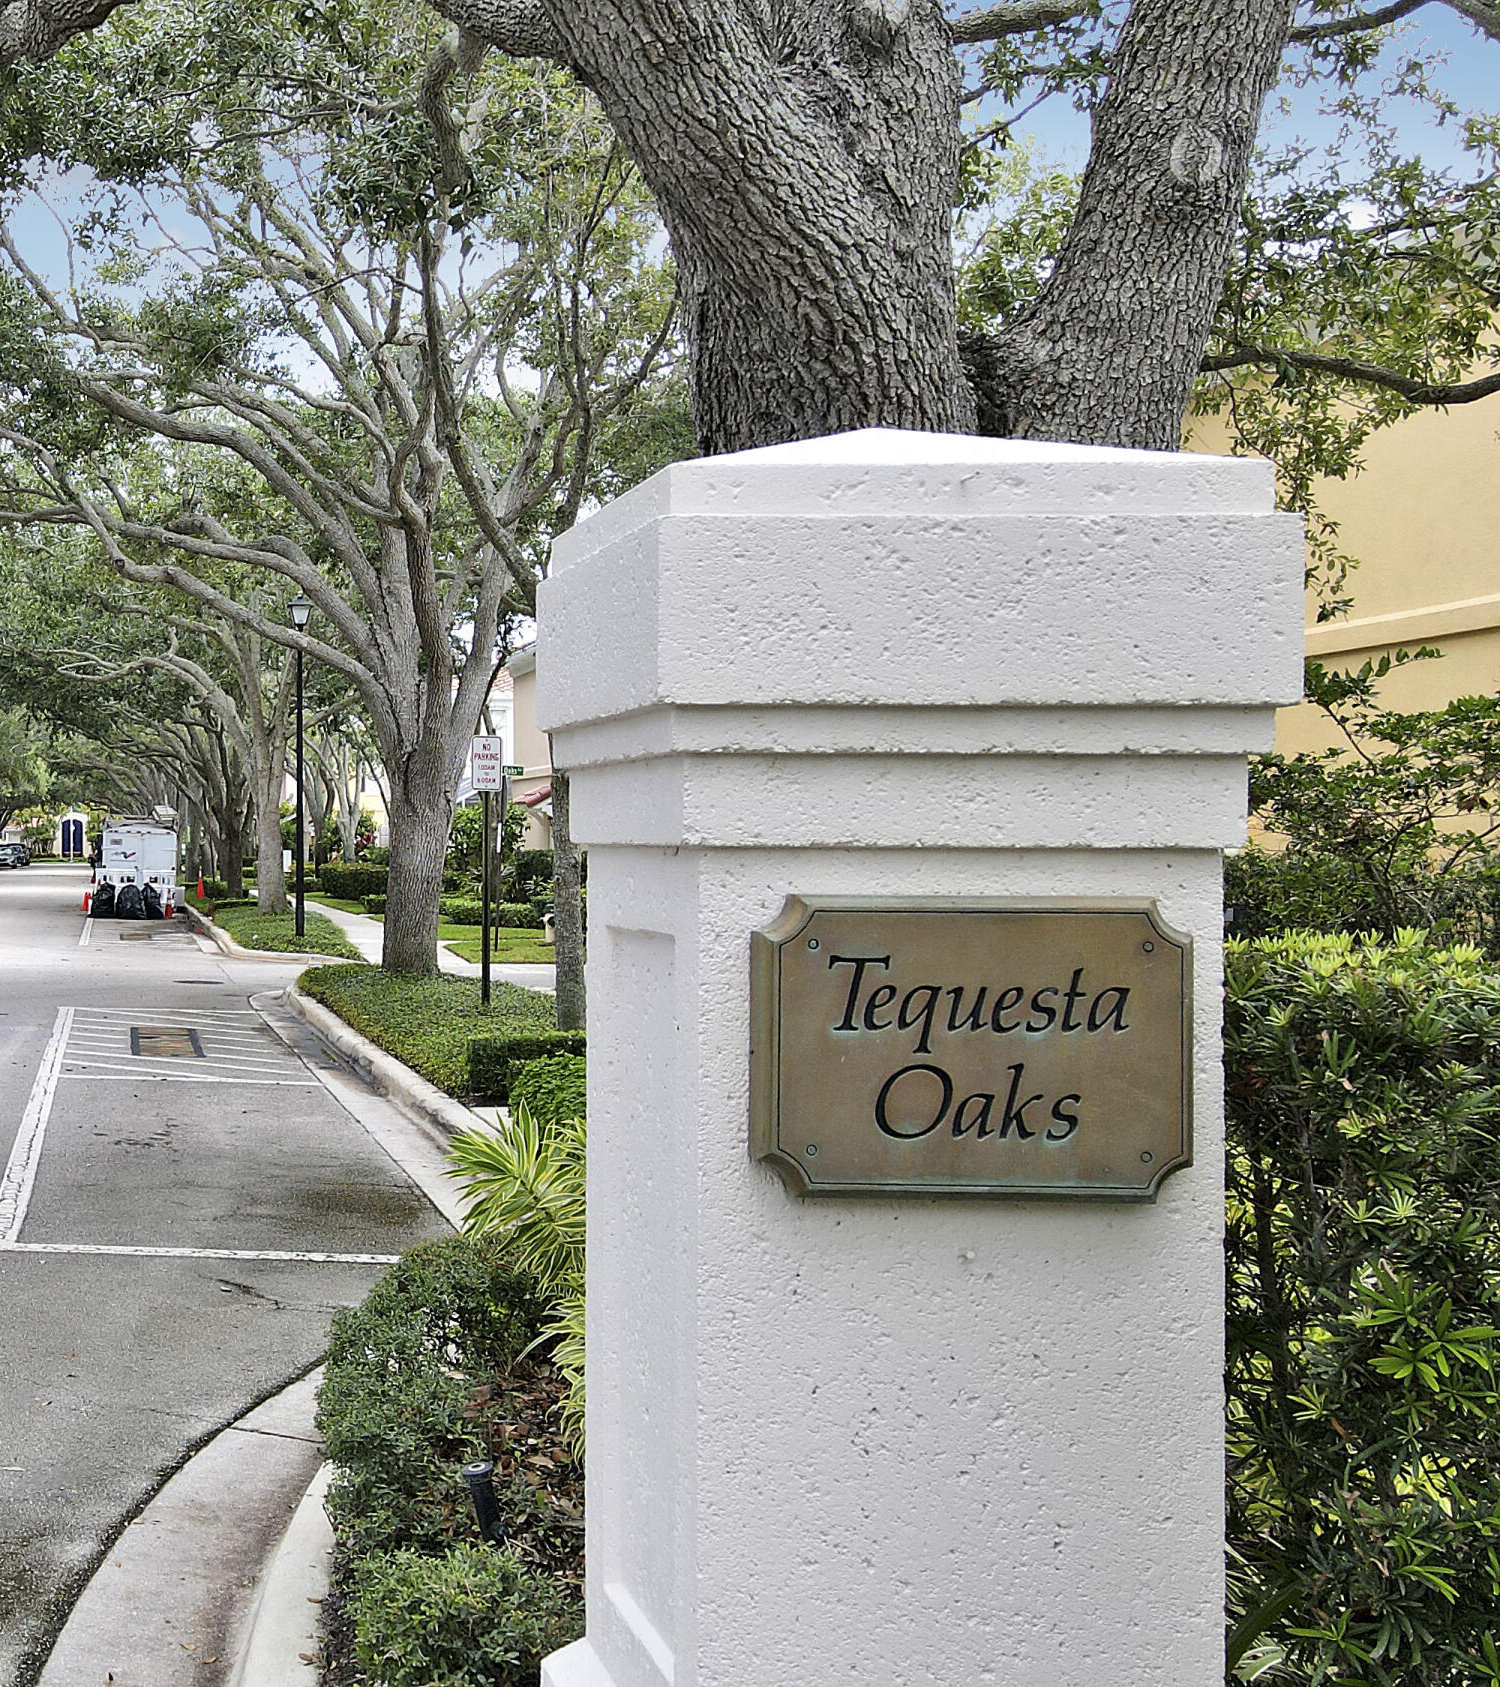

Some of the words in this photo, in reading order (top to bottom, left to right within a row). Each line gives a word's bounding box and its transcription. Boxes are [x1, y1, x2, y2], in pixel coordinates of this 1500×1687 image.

[474, 752, 499, 761] PARKING
[482, 743, 491, 751] NO
[827, 954, 1132, 1055] Tequesta
[874, 1062, 1083, 1143] Oaks
